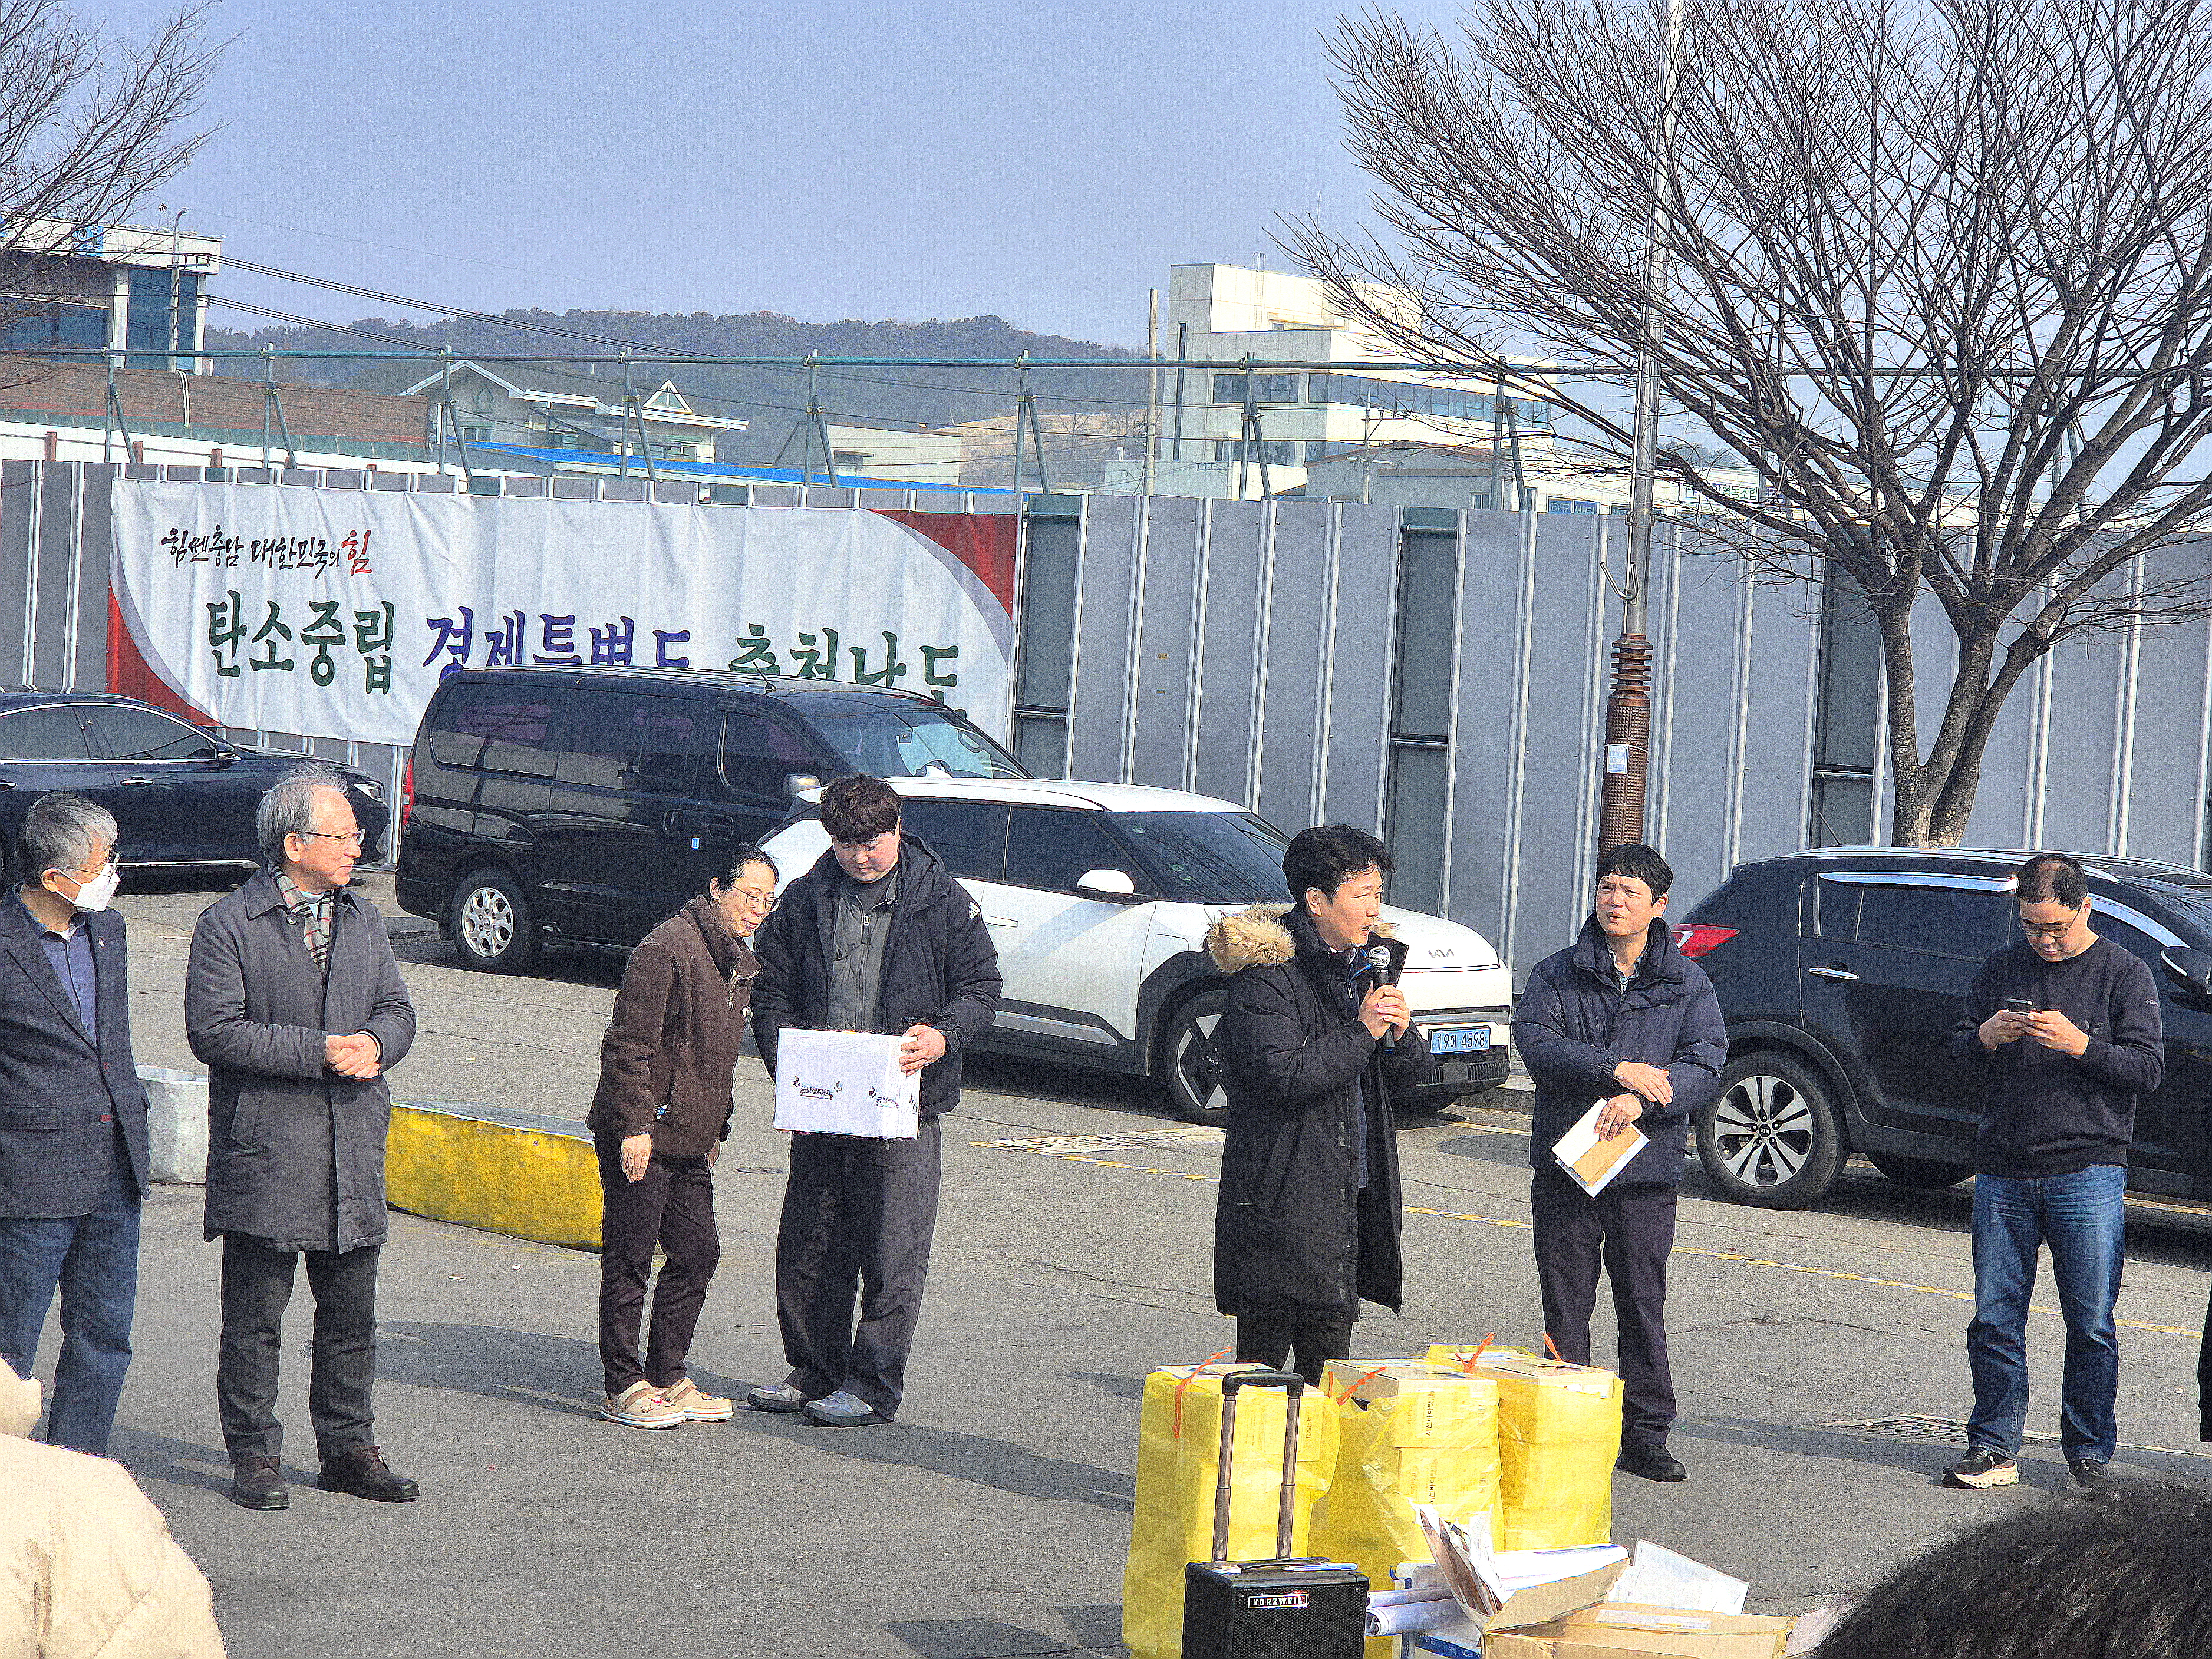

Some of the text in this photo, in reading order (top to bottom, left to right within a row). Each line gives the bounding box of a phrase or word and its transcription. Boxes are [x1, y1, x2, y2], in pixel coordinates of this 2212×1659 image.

[160, 524, 245, 568] 힘쎈충남
[341, 530, 372, 576] 힘
[206, 590, 395, 695] 탄소중립
[1461, 1031, 1485, 1048] 4598
[1252, 1596, 1303, 1606] KURZWEIL
